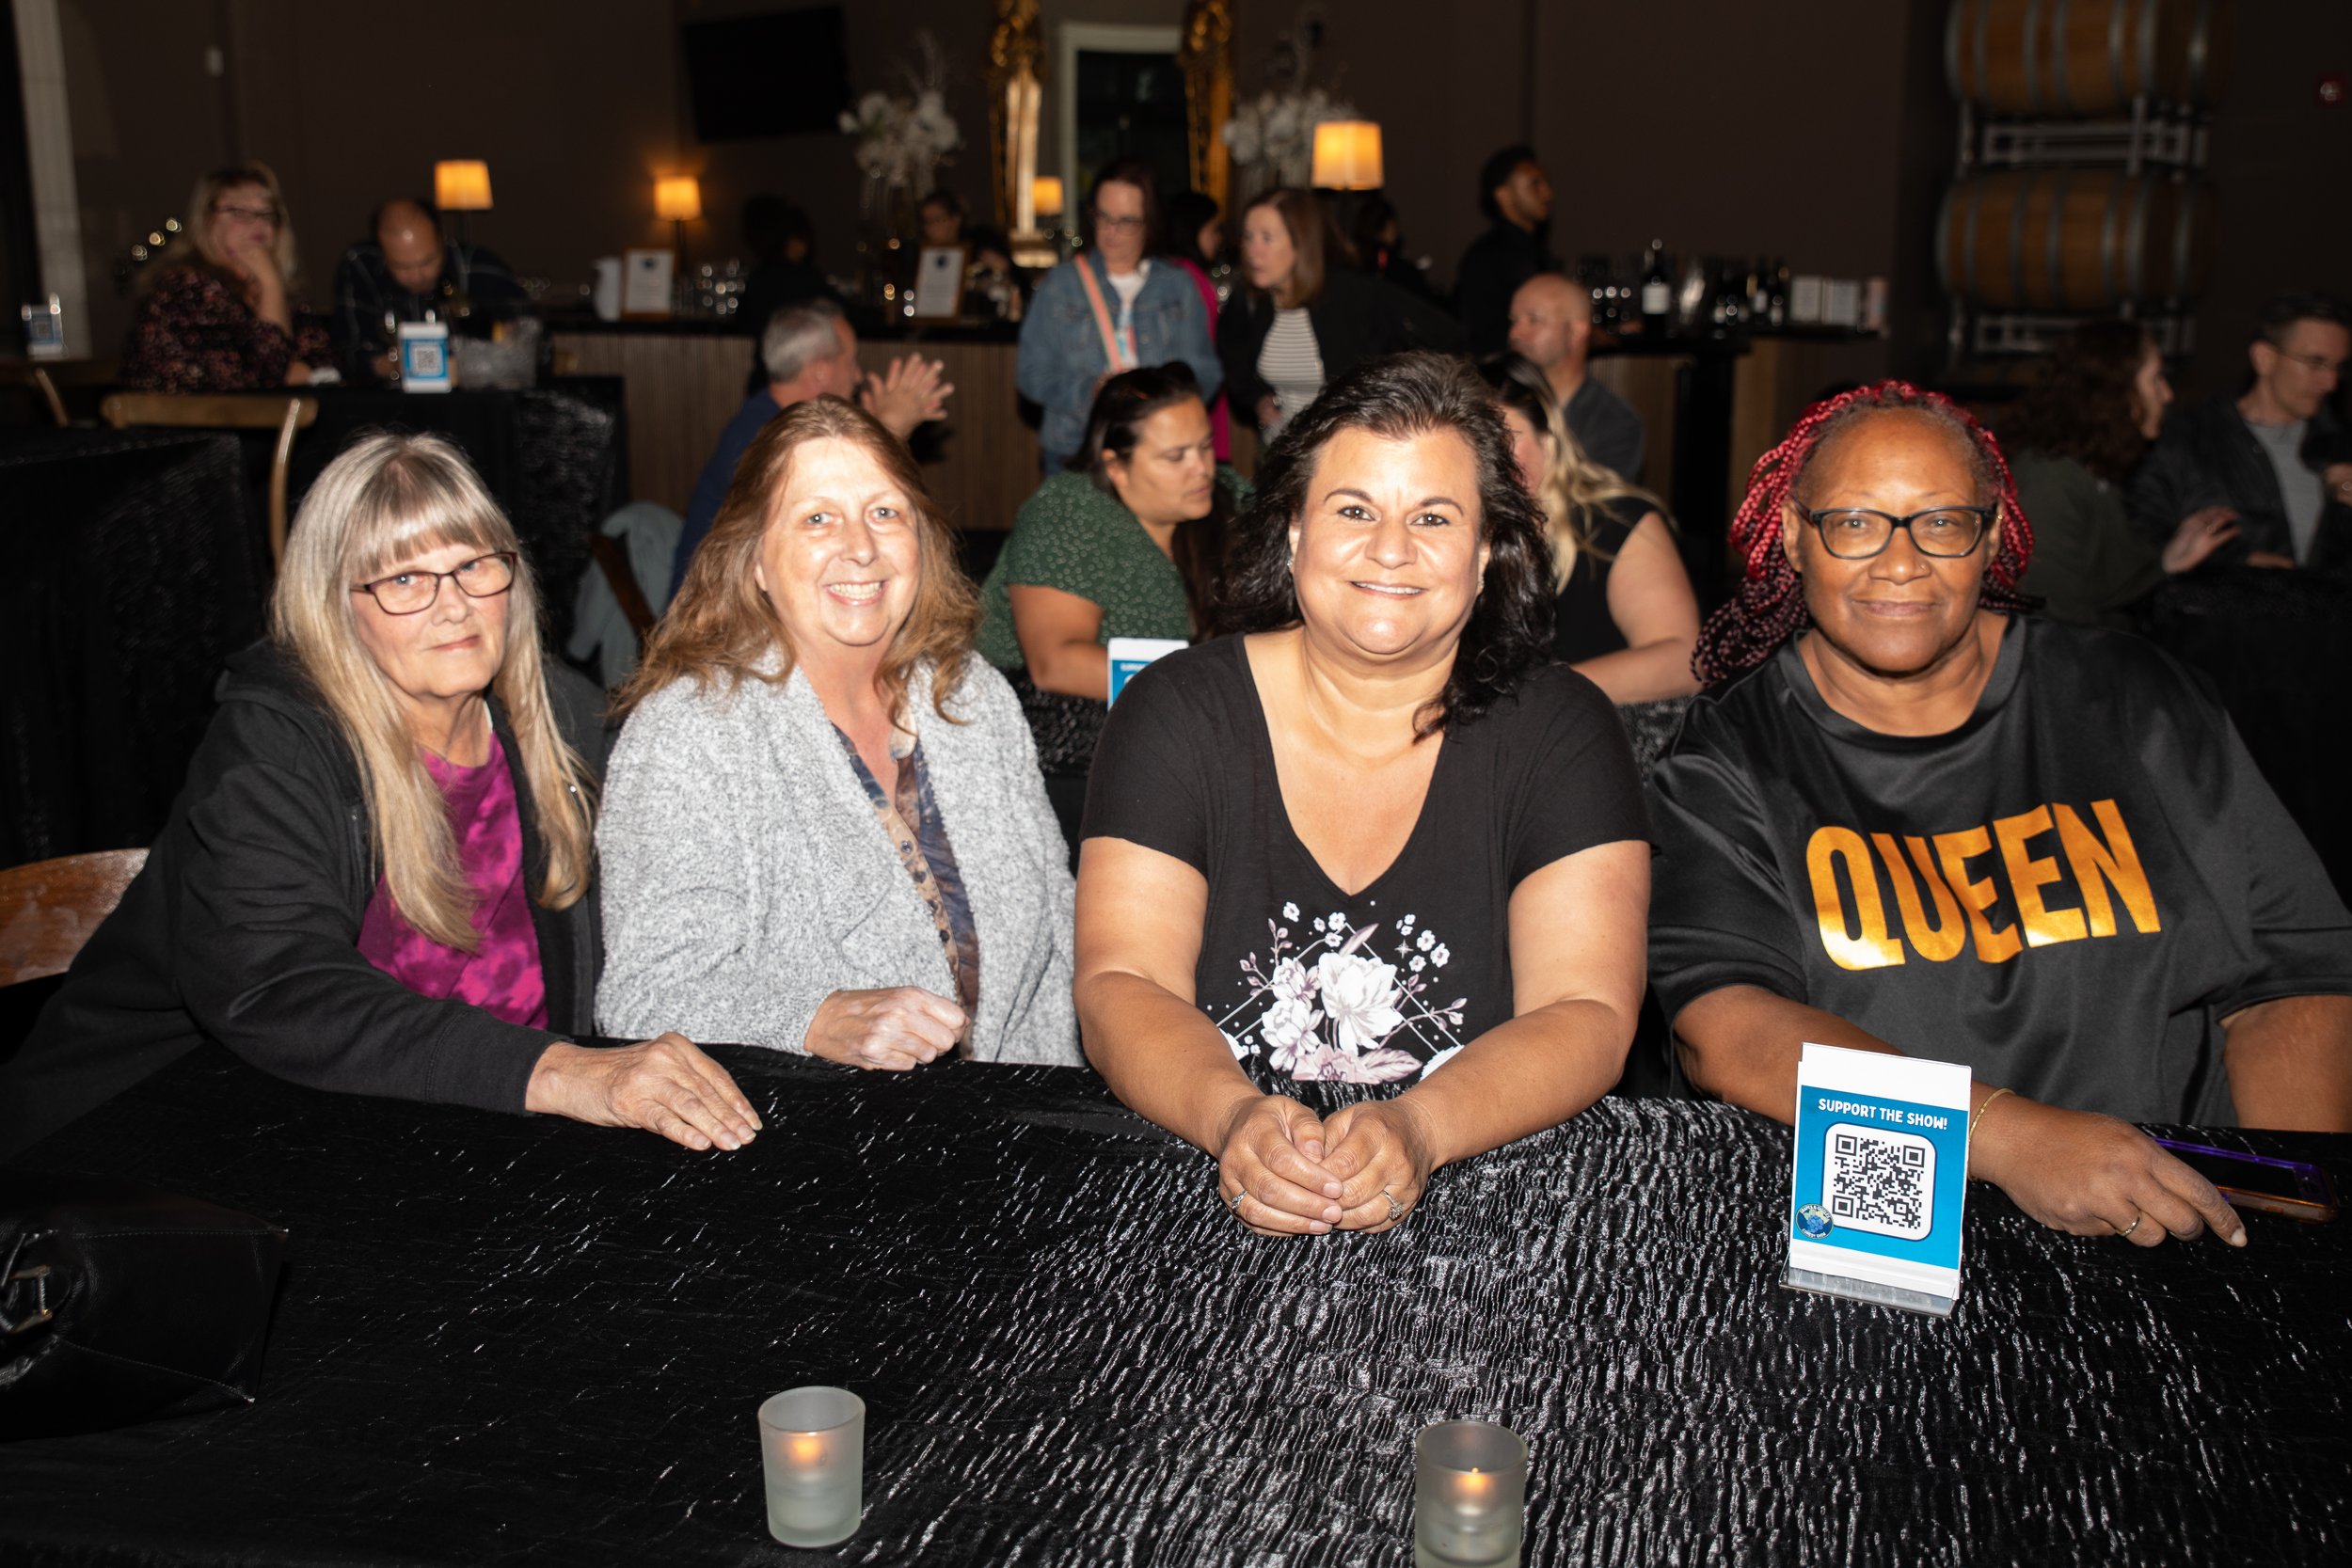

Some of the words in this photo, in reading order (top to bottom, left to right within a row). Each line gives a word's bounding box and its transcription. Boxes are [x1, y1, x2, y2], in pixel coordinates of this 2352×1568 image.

[1806, 799, 2161, 971] QUEEN
[1818, 1098, 1877, 1118] SUPPORT
[1879, 1107, 1904, 1123] THE
[1906, 1112, 1948, 1131] SHOW!
